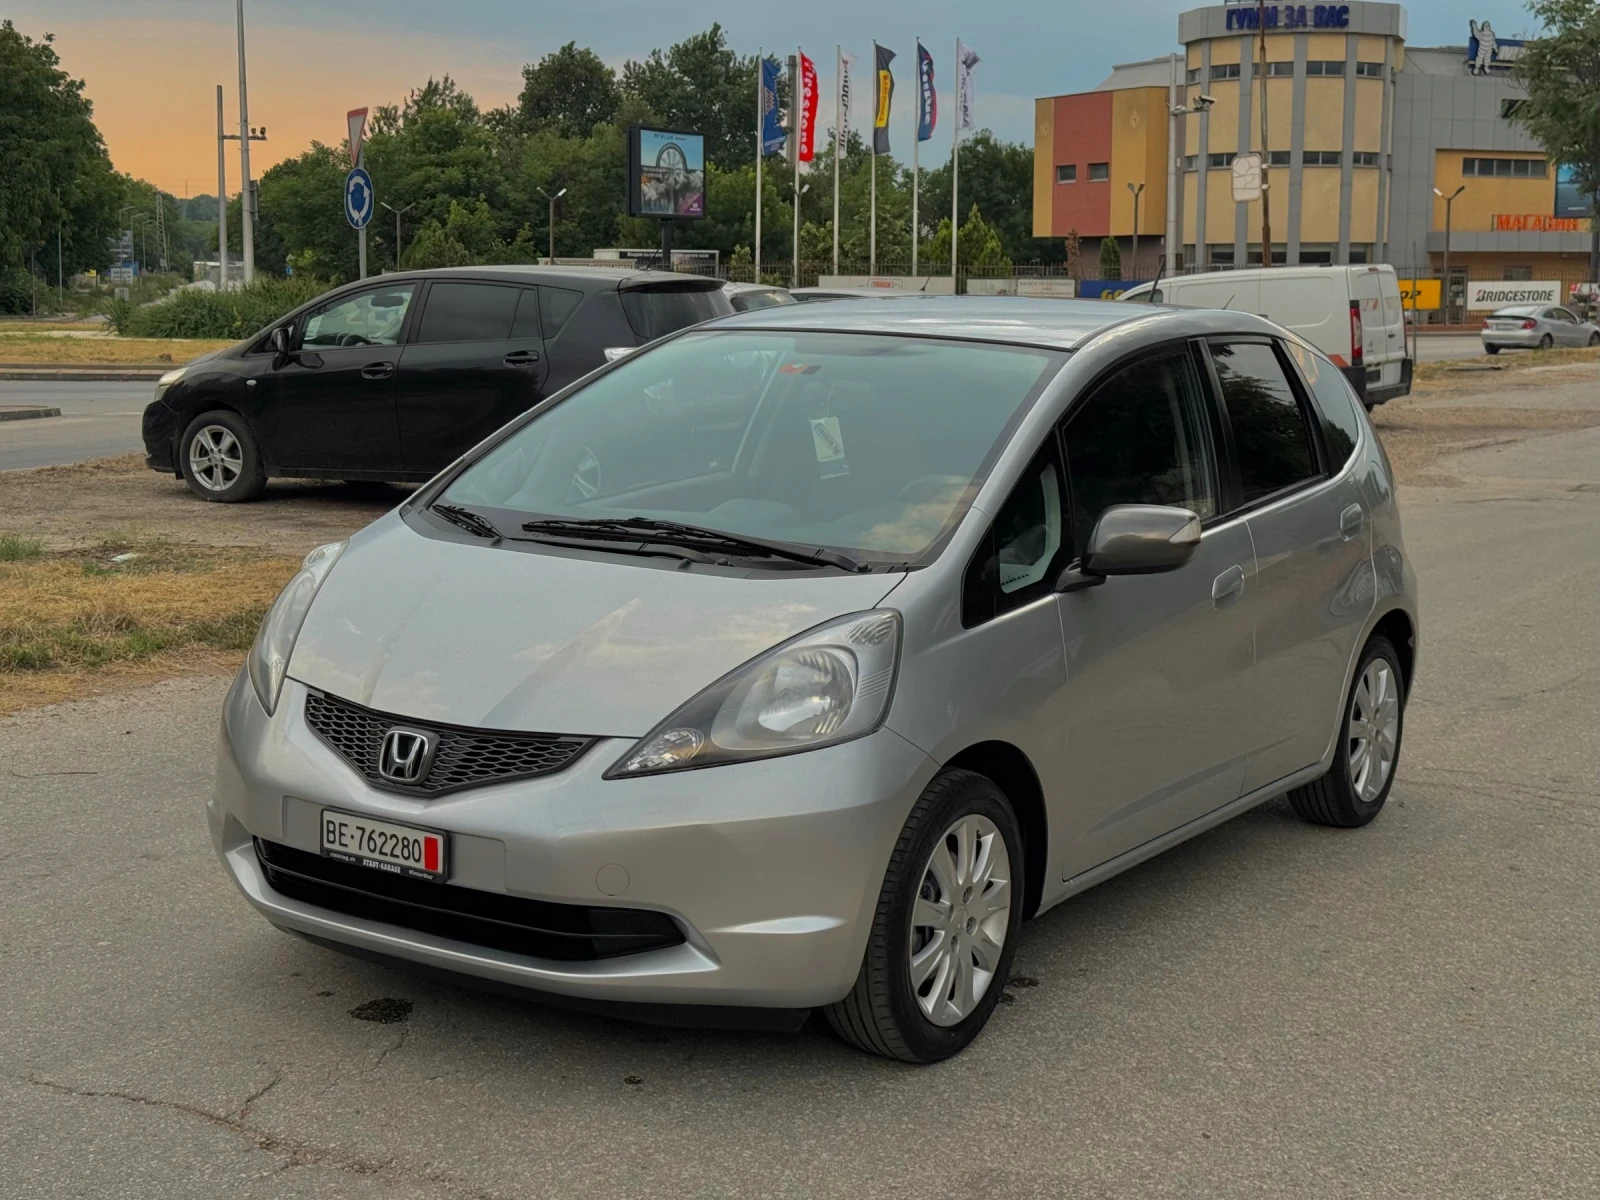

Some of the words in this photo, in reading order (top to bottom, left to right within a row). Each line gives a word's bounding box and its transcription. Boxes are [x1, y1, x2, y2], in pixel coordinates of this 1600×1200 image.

[1226, 6, 1278, 30] ГУМИ
[1284, 5, 1307, 28] ЗА
[1314, 5, 1350, 28] ВАС
[839, 57, 849, 152] BIDGETONE
[1475, 290, 1555, 303] BRIDGESTONE
